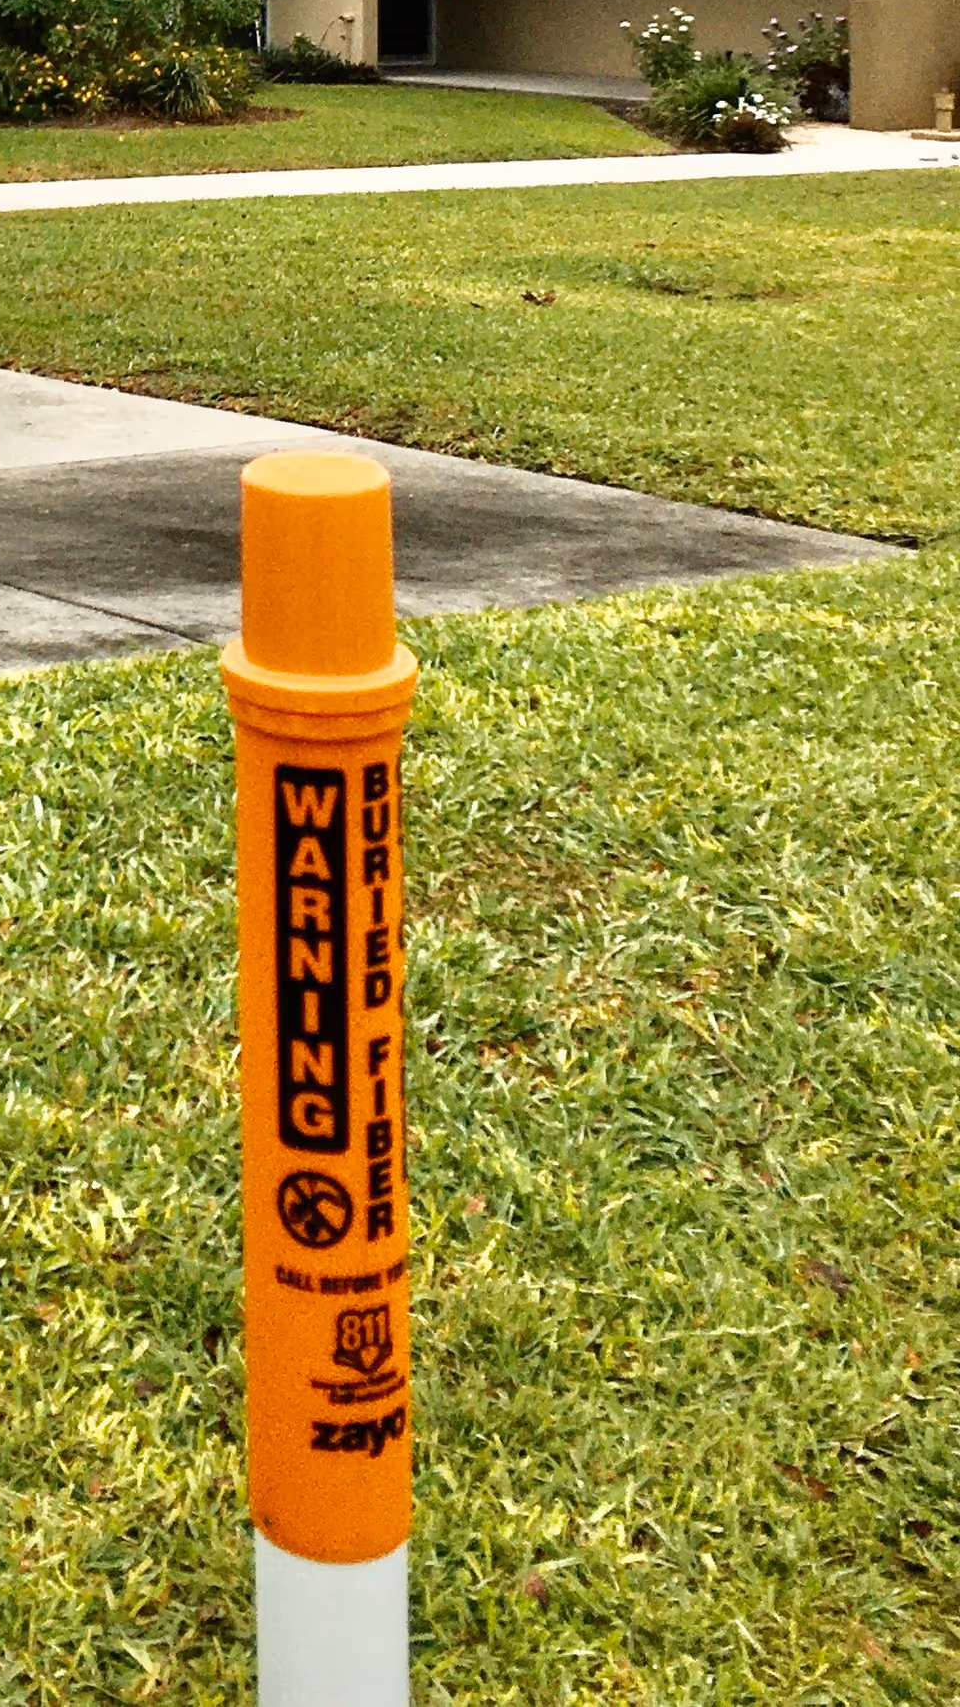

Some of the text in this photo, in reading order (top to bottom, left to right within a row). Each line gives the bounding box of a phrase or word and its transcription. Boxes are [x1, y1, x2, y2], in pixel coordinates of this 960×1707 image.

[281, 781, 336, 1139] WARNING
[362, 763, 393, 1243] BURIED FIBER
[311, 1407, 406, 1458] zayo
[341, 1312, 387, 1352] 811
